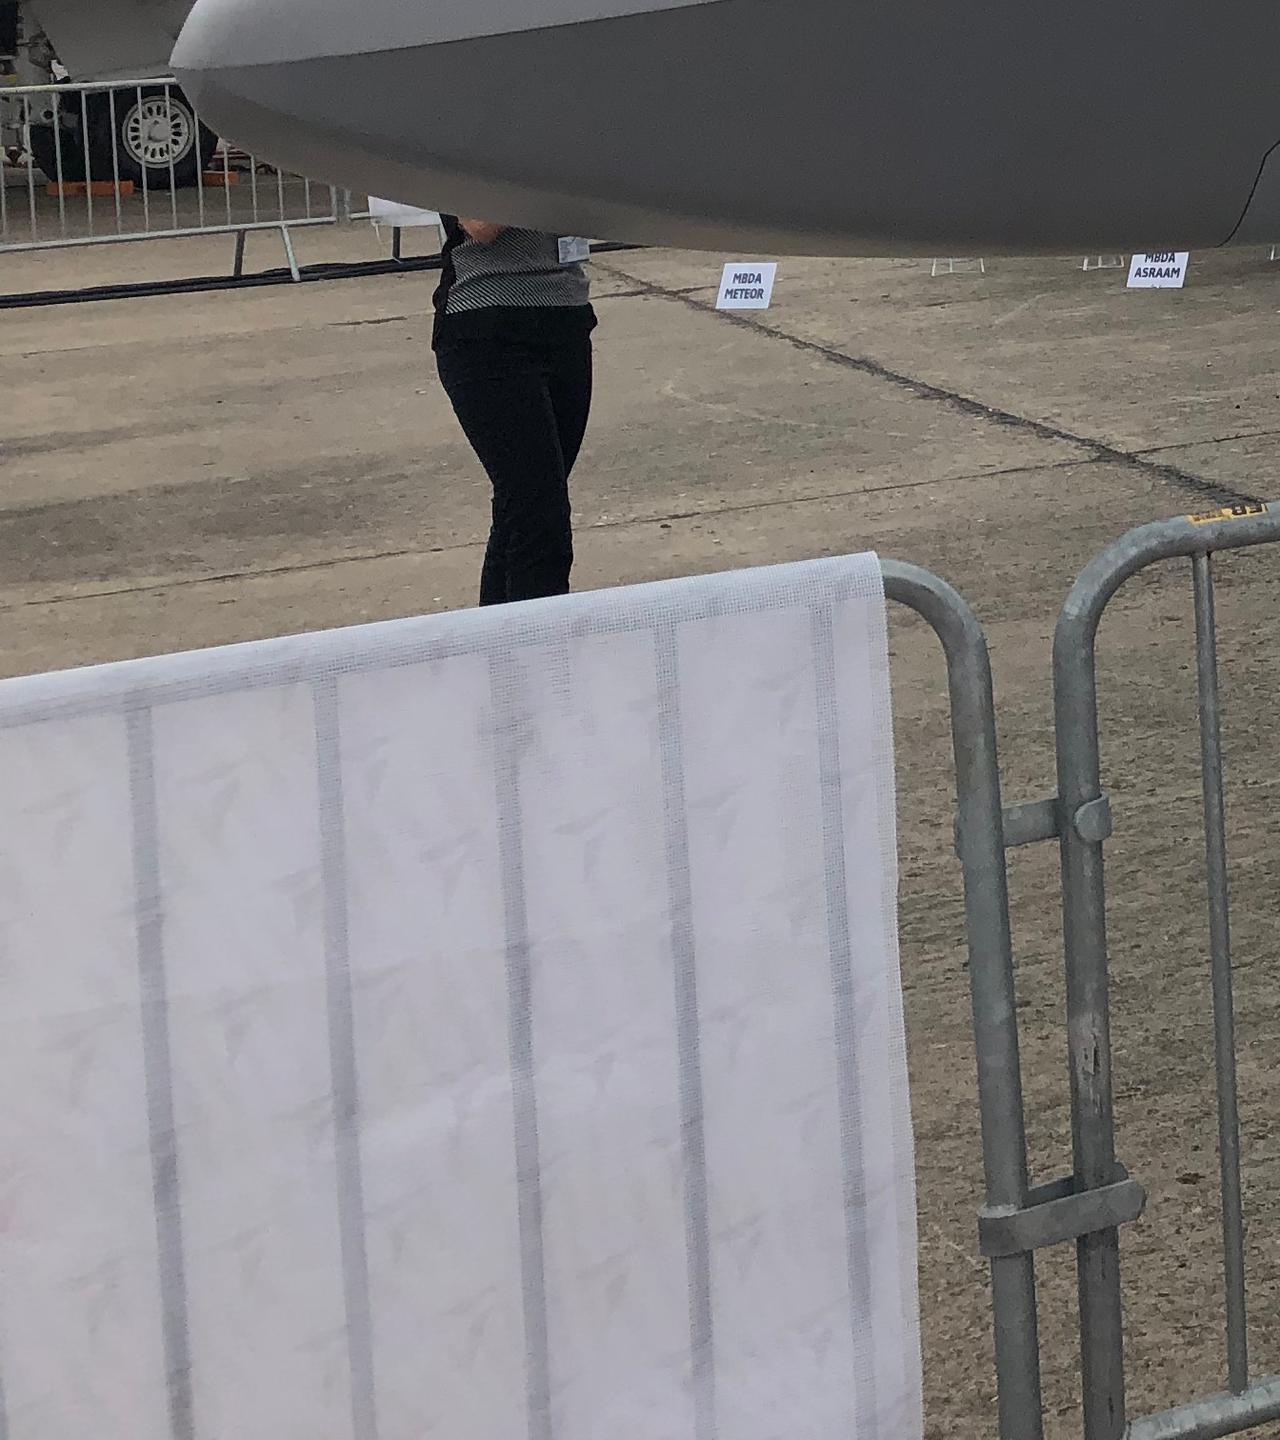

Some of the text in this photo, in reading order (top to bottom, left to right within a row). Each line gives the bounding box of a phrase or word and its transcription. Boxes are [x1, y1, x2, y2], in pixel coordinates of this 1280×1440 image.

[1144, 252, 1176, 263] MBDA
[732, 272, 762, 284] MBDA
[1133, 267, 1181, 279] ASRAAM
[724, 288, 765, 300] METEOR
